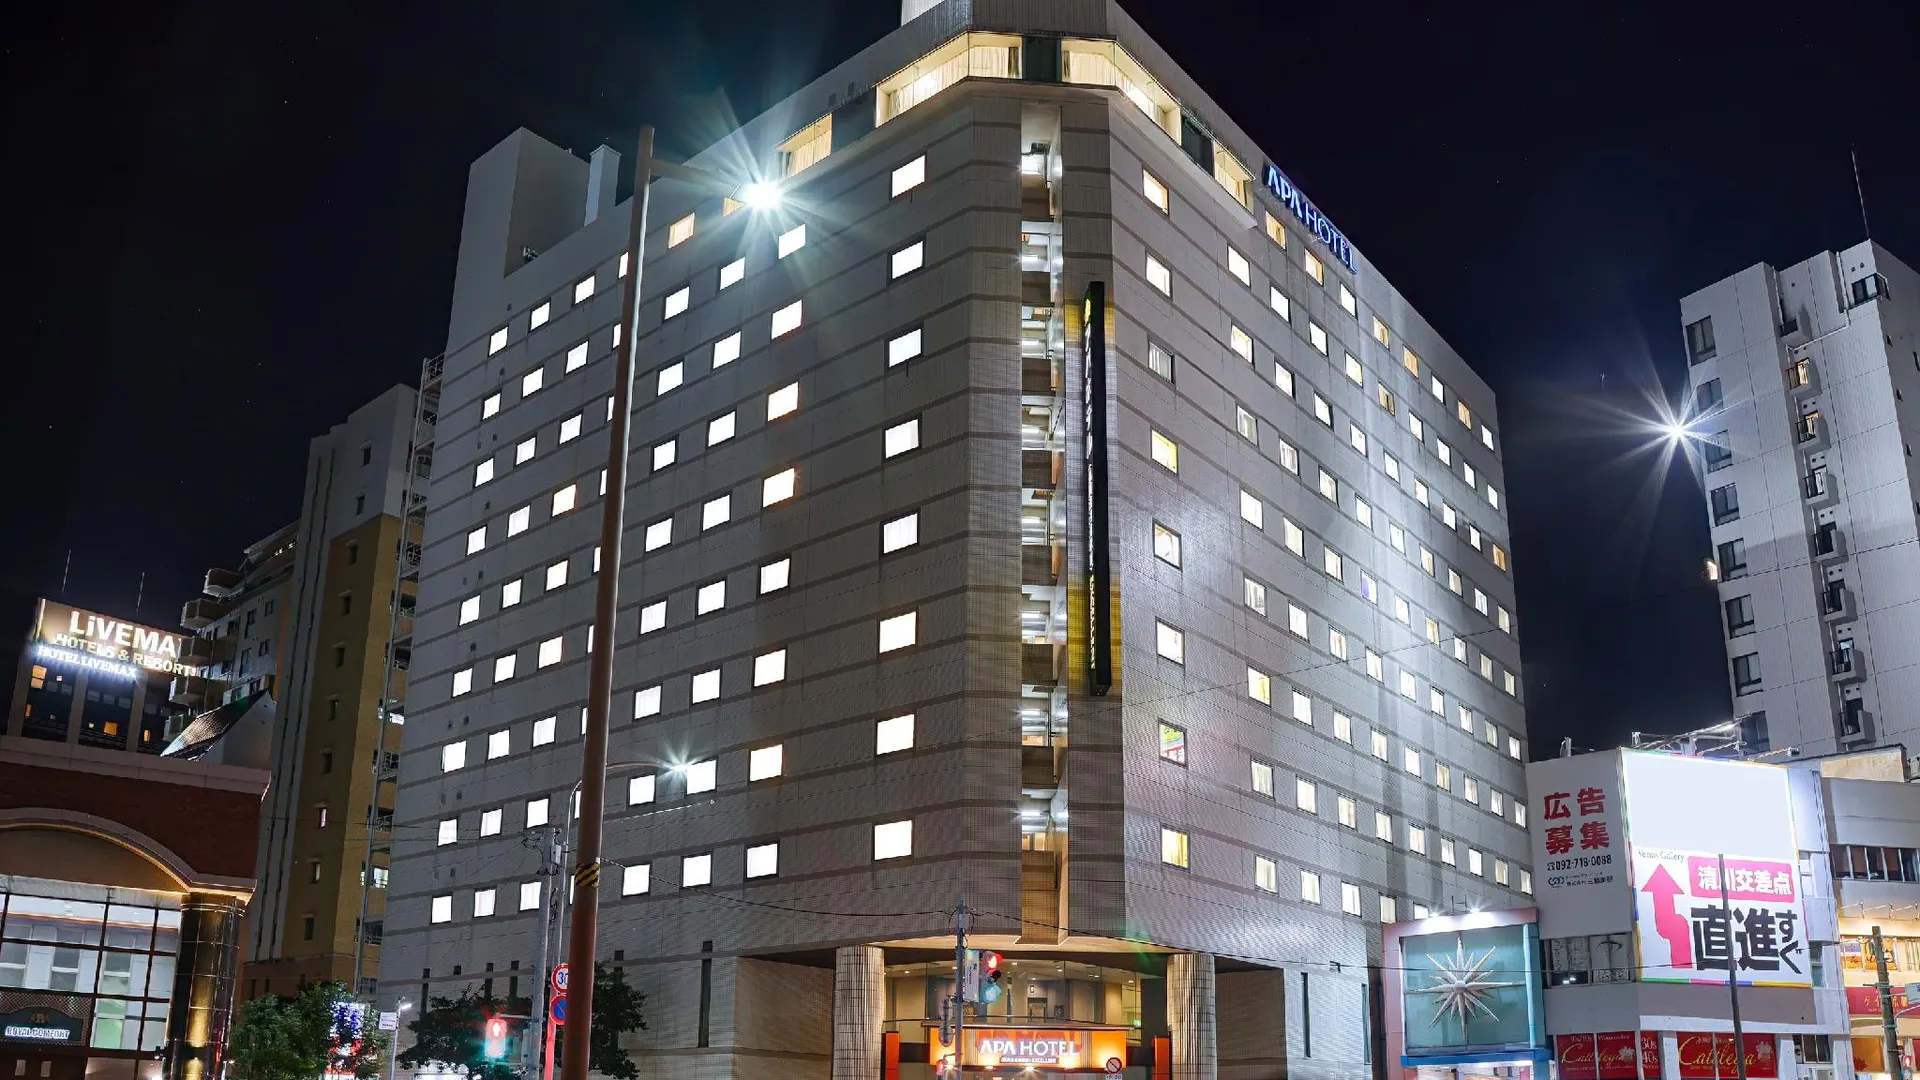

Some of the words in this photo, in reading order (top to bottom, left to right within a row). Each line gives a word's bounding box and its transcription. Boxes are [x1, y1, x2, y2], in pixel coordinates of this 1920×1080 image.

[1267, 165, 1303, 219] APA
[1305, 202, 1359, 274] HOTEL
[54, 633, 116, 659] HOTELS
[117, 649, 130, 663] &
[68, 610, 182, 661] LiVEMA
[37, 645, 80, 665] HOTEL
[1543, 787, 1606, 821] 広告
[1545, 821, 1610, 856] 募集
[1555, 855, 1612, 871] 092-718-0088
[1659, 850, 1685, 863] Gallery
[1697, 865, 1793, 896] 清川交差点
[1690, 904, 1781, 972] 直進
[1775, 909, 1803, 975] すぐ
[5, 1026, 32, 1037] ROYAL
[32, 1027, 70, 1040] COMFORT
[979, 1040, 1016, 1055] APA
[1020, 1040, 1080, 1056] HOTEL
